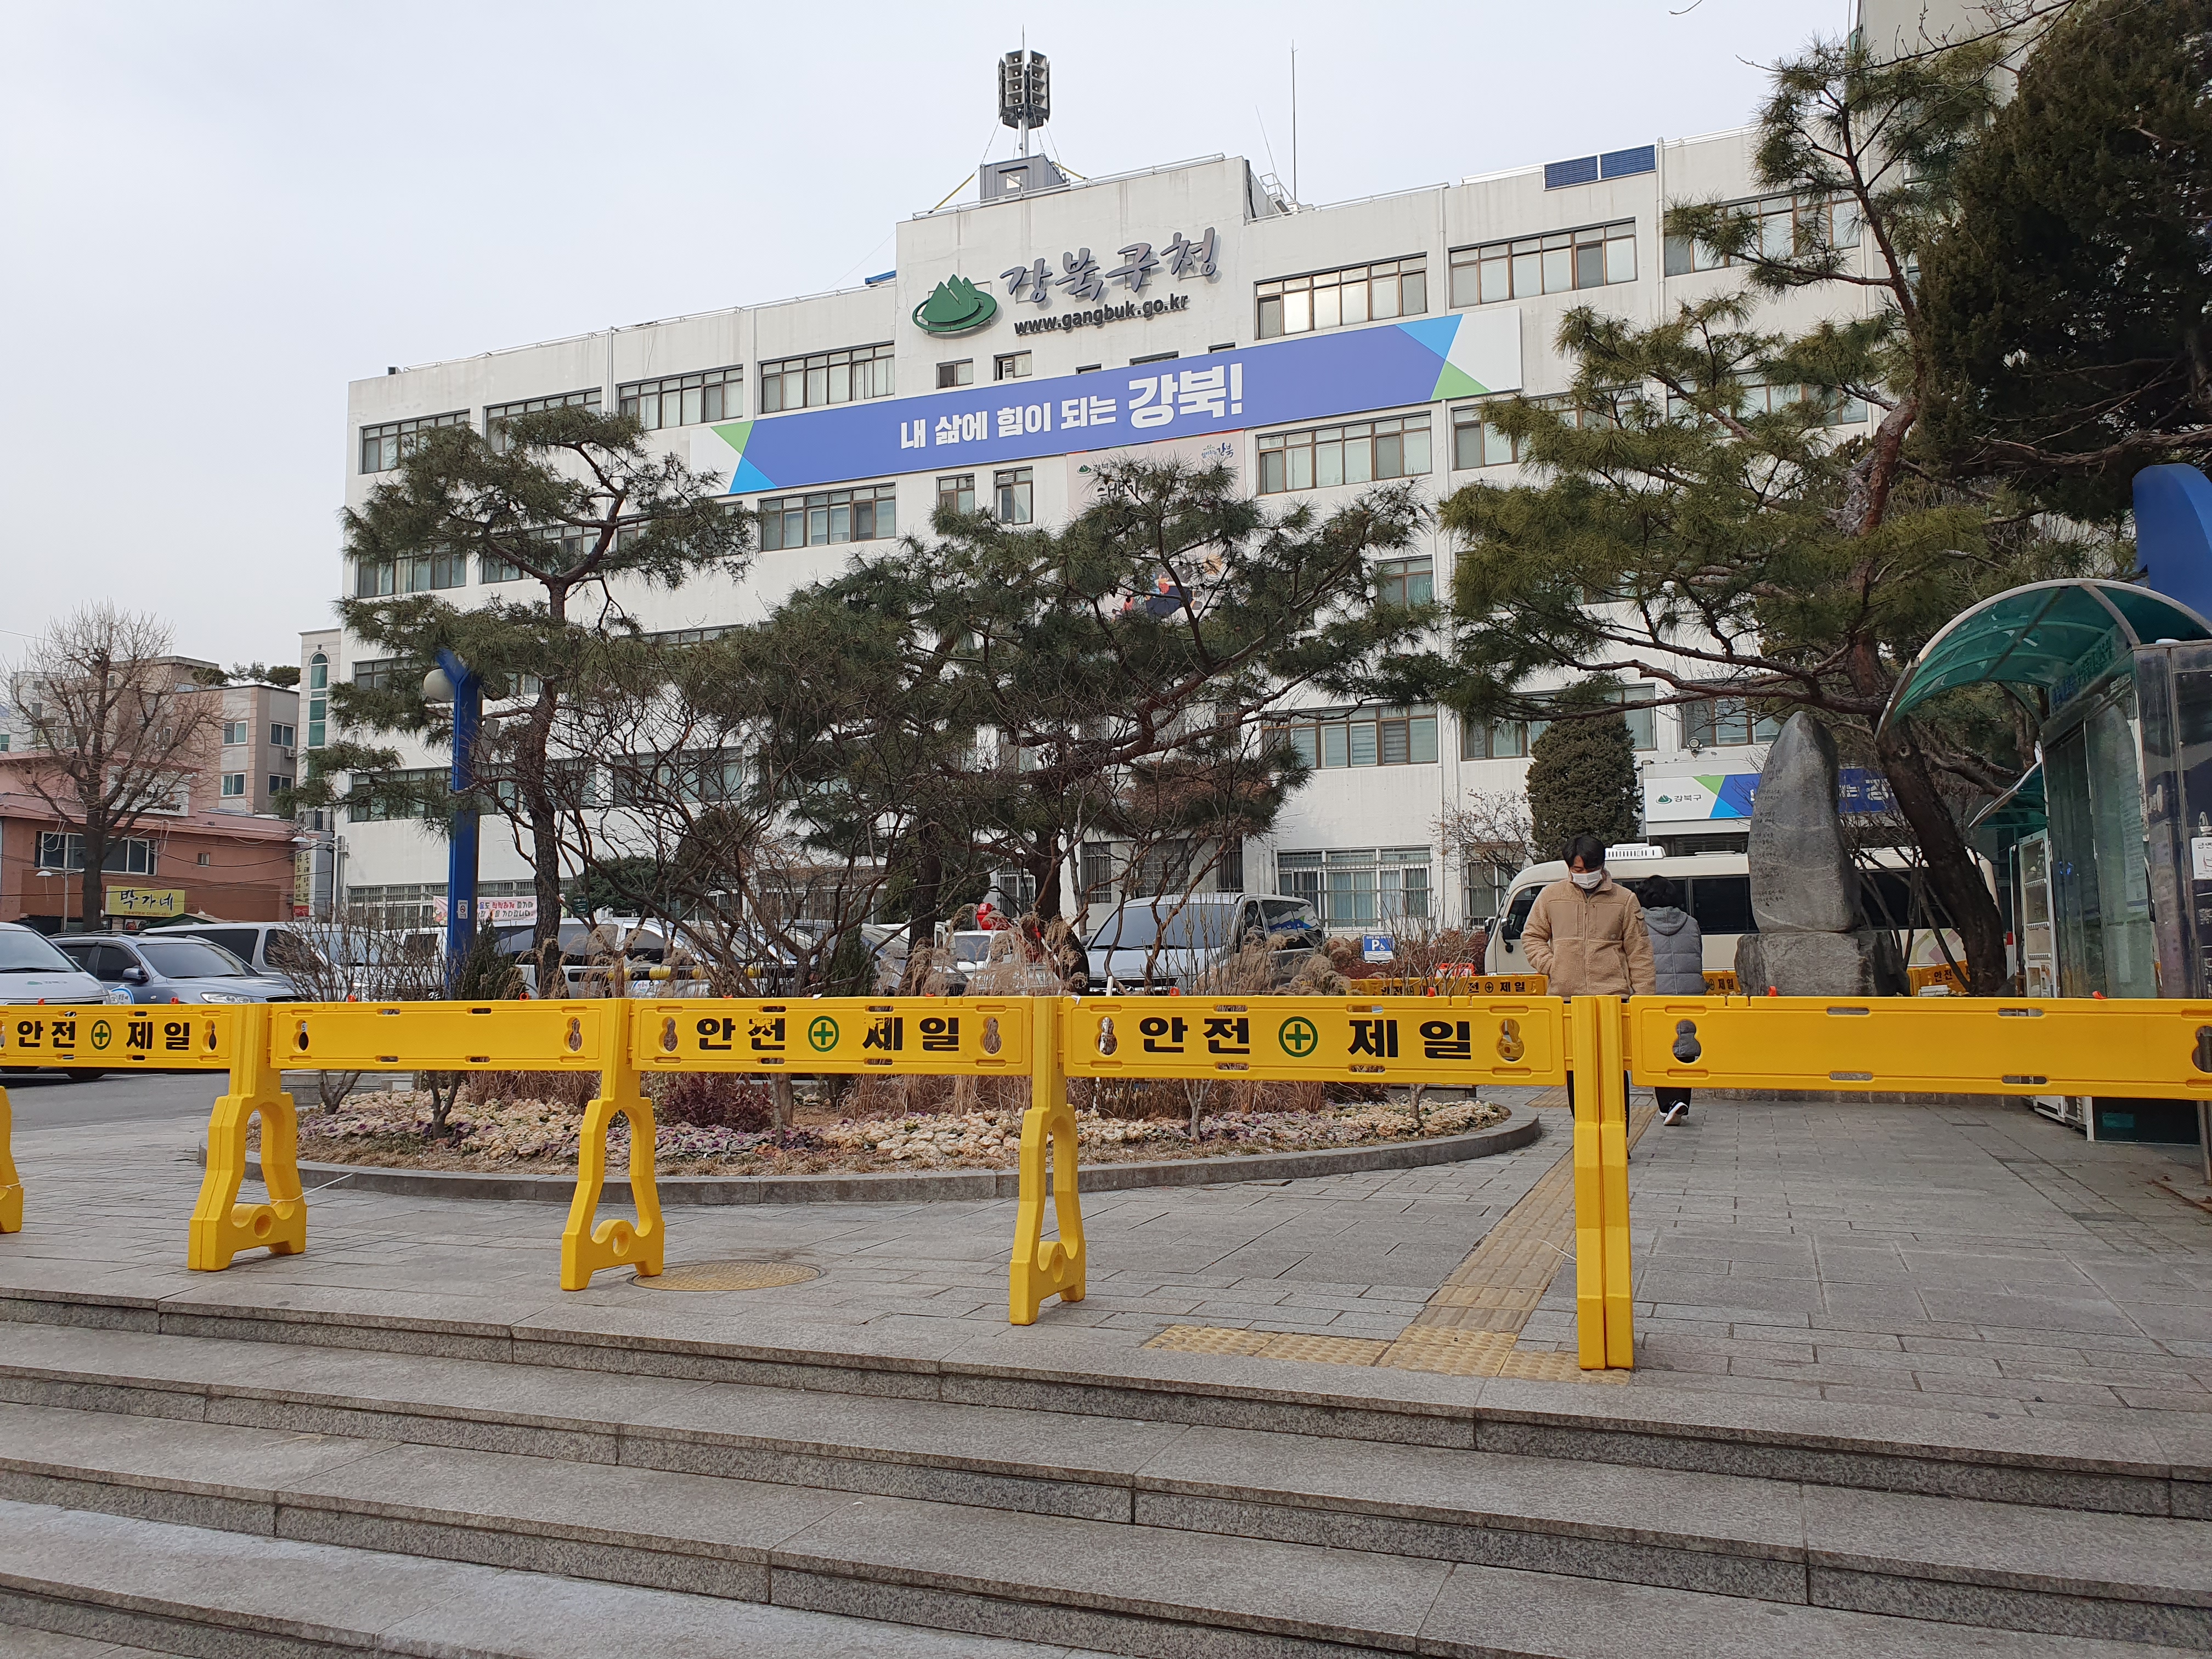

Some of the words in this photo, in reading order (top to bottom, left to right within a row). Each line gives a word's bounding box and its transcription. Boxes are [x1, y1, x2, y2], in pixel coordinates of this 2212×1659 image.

[1000, 227, 1216, 303] 강북구청
[1014, 293, 1188, 334] www.gangbuk.go.kr
[901, 419, 926, 449] 내
[935, 411, 988, 445] 삶에
[996, 402, 1051, 438] 힘이
[1060, 396, 1116, 430] 되는
[1128, 363, 1243, 430] 강북!
[1216, 442, 1233, 458] 강북
[1674, 794, 1702, 803] 강북구
[120, 889, 173, 911] 박가네
[1372, 940, 1380, 951] P
[1500, 981, 1525, 992] 제일
[1718, 978, 1734, 990] 제일
[1934, 969, 1953, 983] 안전
[17, 1020, 76, 1048] 안전
[126, 1022, 190, 1050] 제일
[696, 1018, 786, 1051] 안전
[862, 1017, 960, 1051] 제일
[1139, 1017, 1250, 1054] 안전
[1348, 1019, 1472, 1060] 제일
